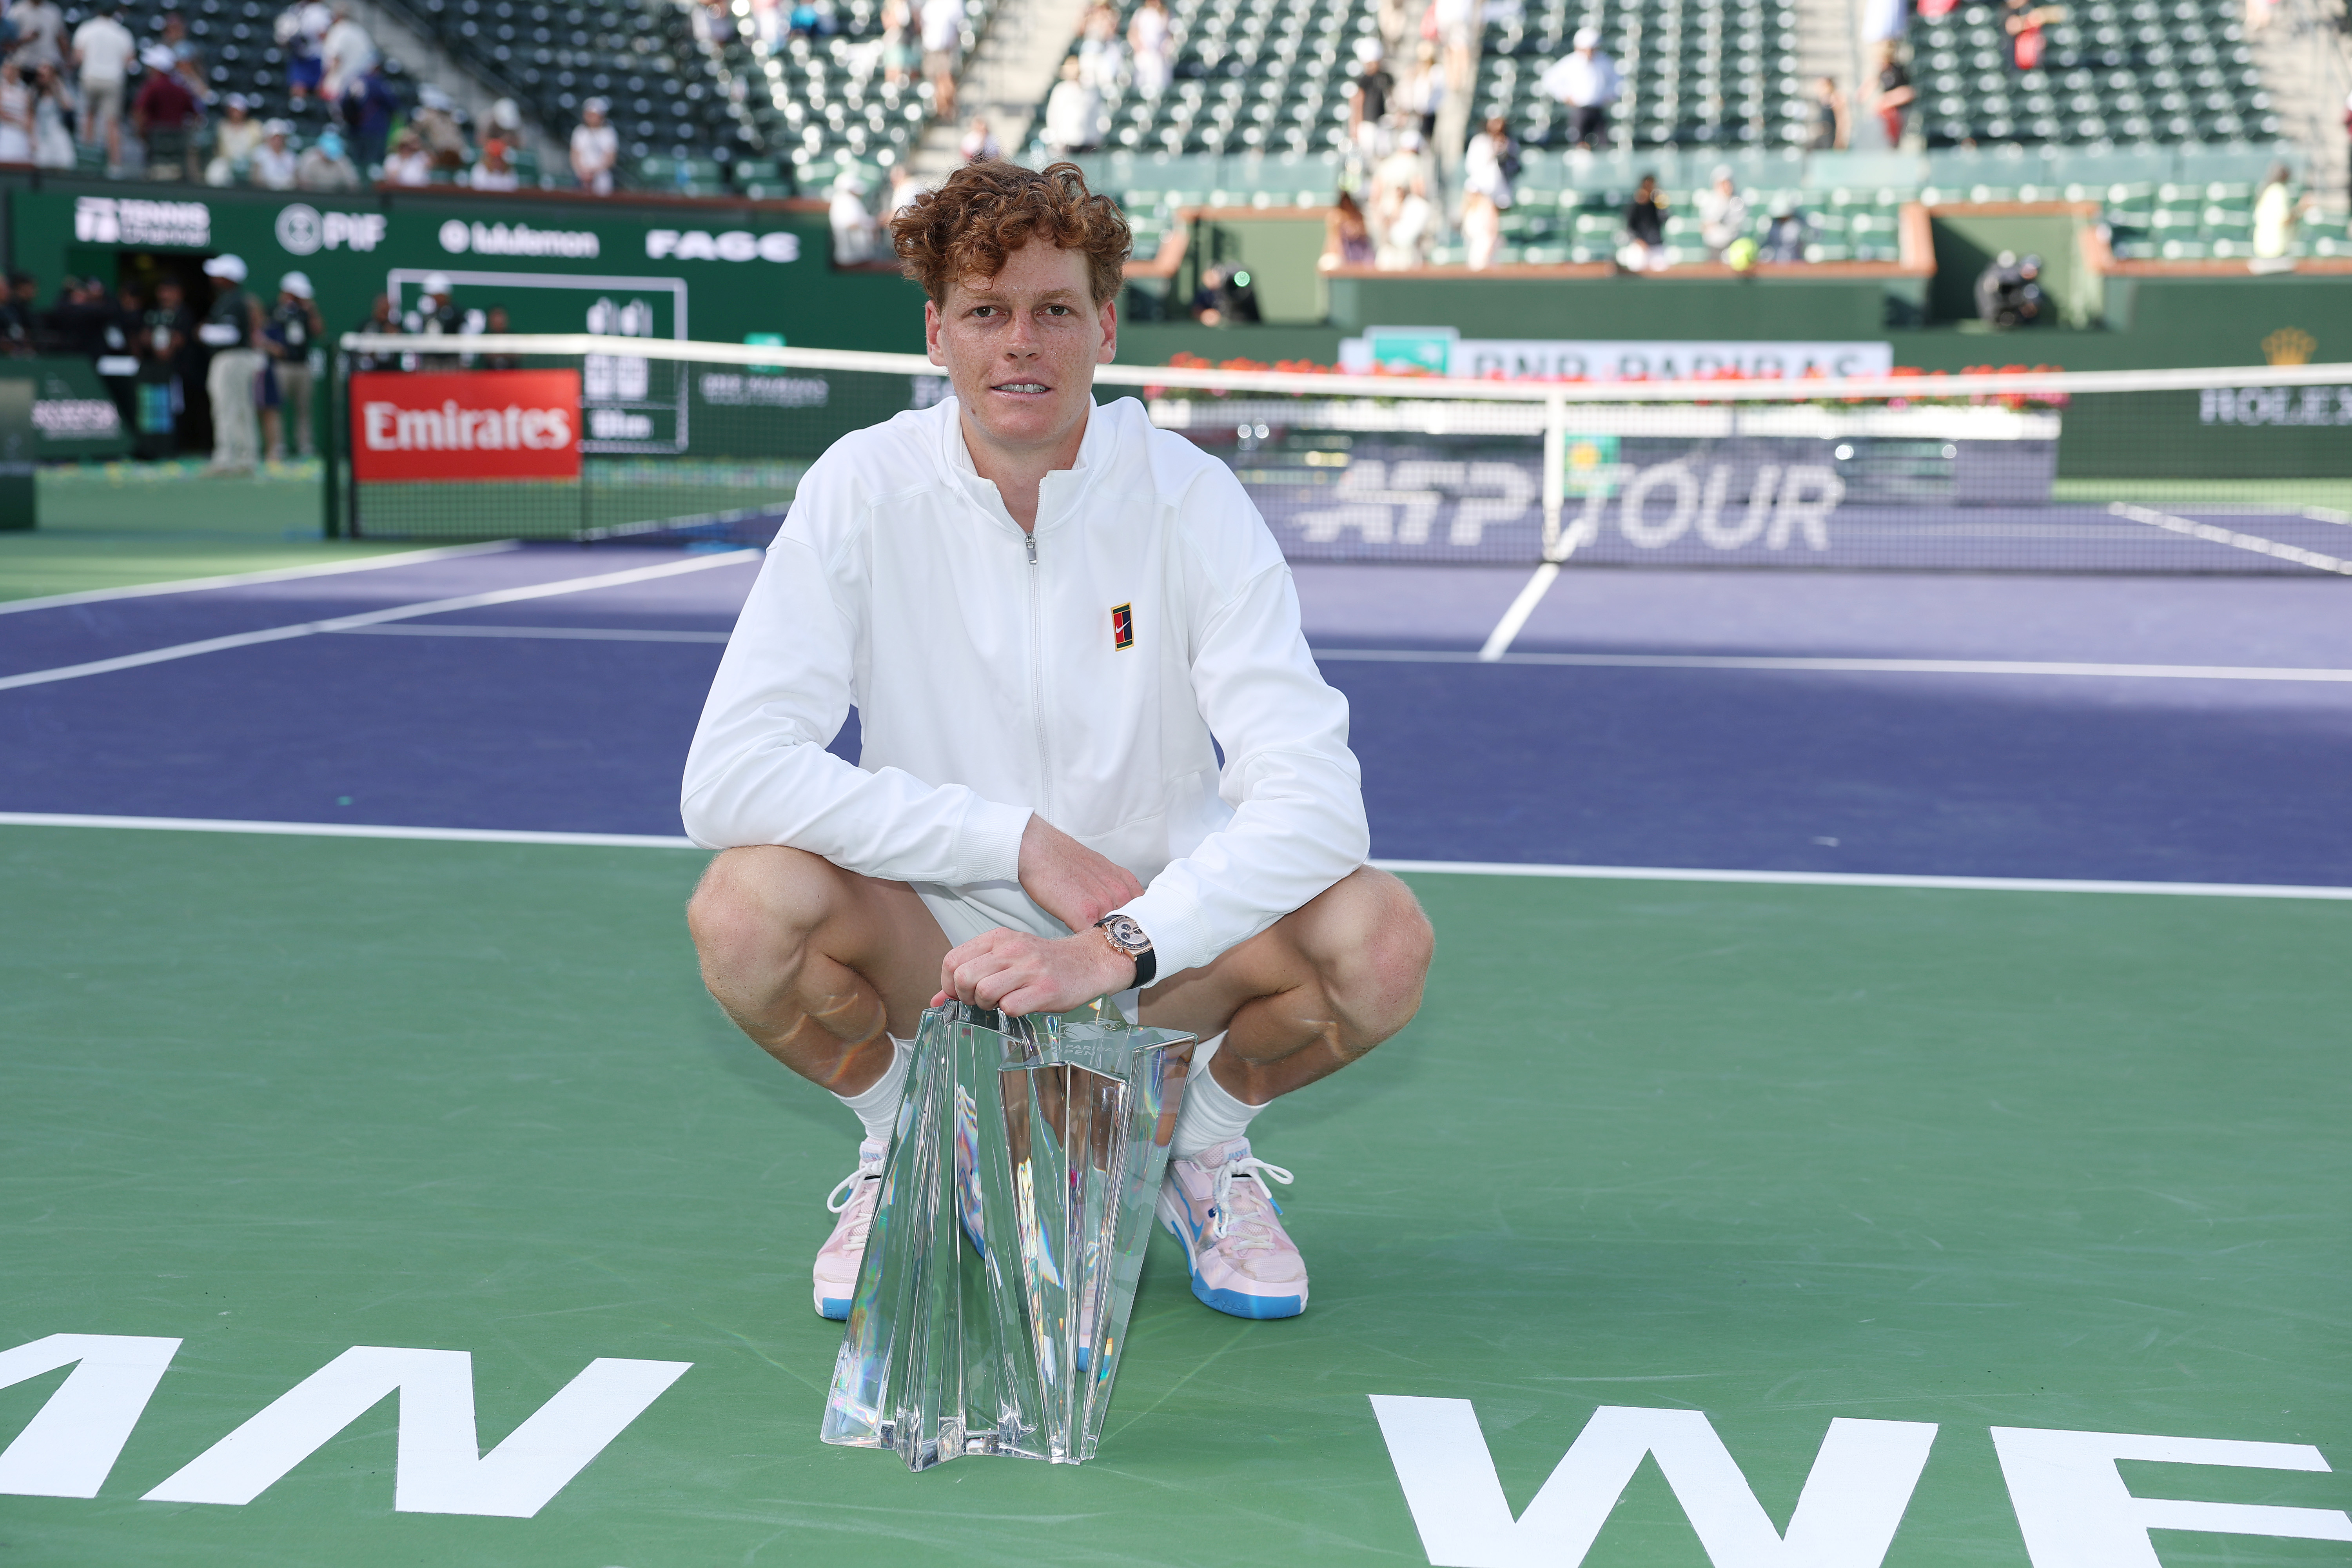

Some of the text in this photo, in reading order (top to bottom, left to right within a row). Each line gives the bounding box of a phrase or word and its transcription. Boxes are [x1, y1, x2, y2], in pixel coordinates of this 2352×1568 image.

[323, 212, 387, 252] PIF
[472, 221, 600, 258] lululemon
[363, 399, 572, 452] Emirates
[1291, 459, 1847, 551] ATP TOUR
[1052, 1048, 1096, 1056] OPEN
[1065, 1044, 1122, 1053] PARIBAS
